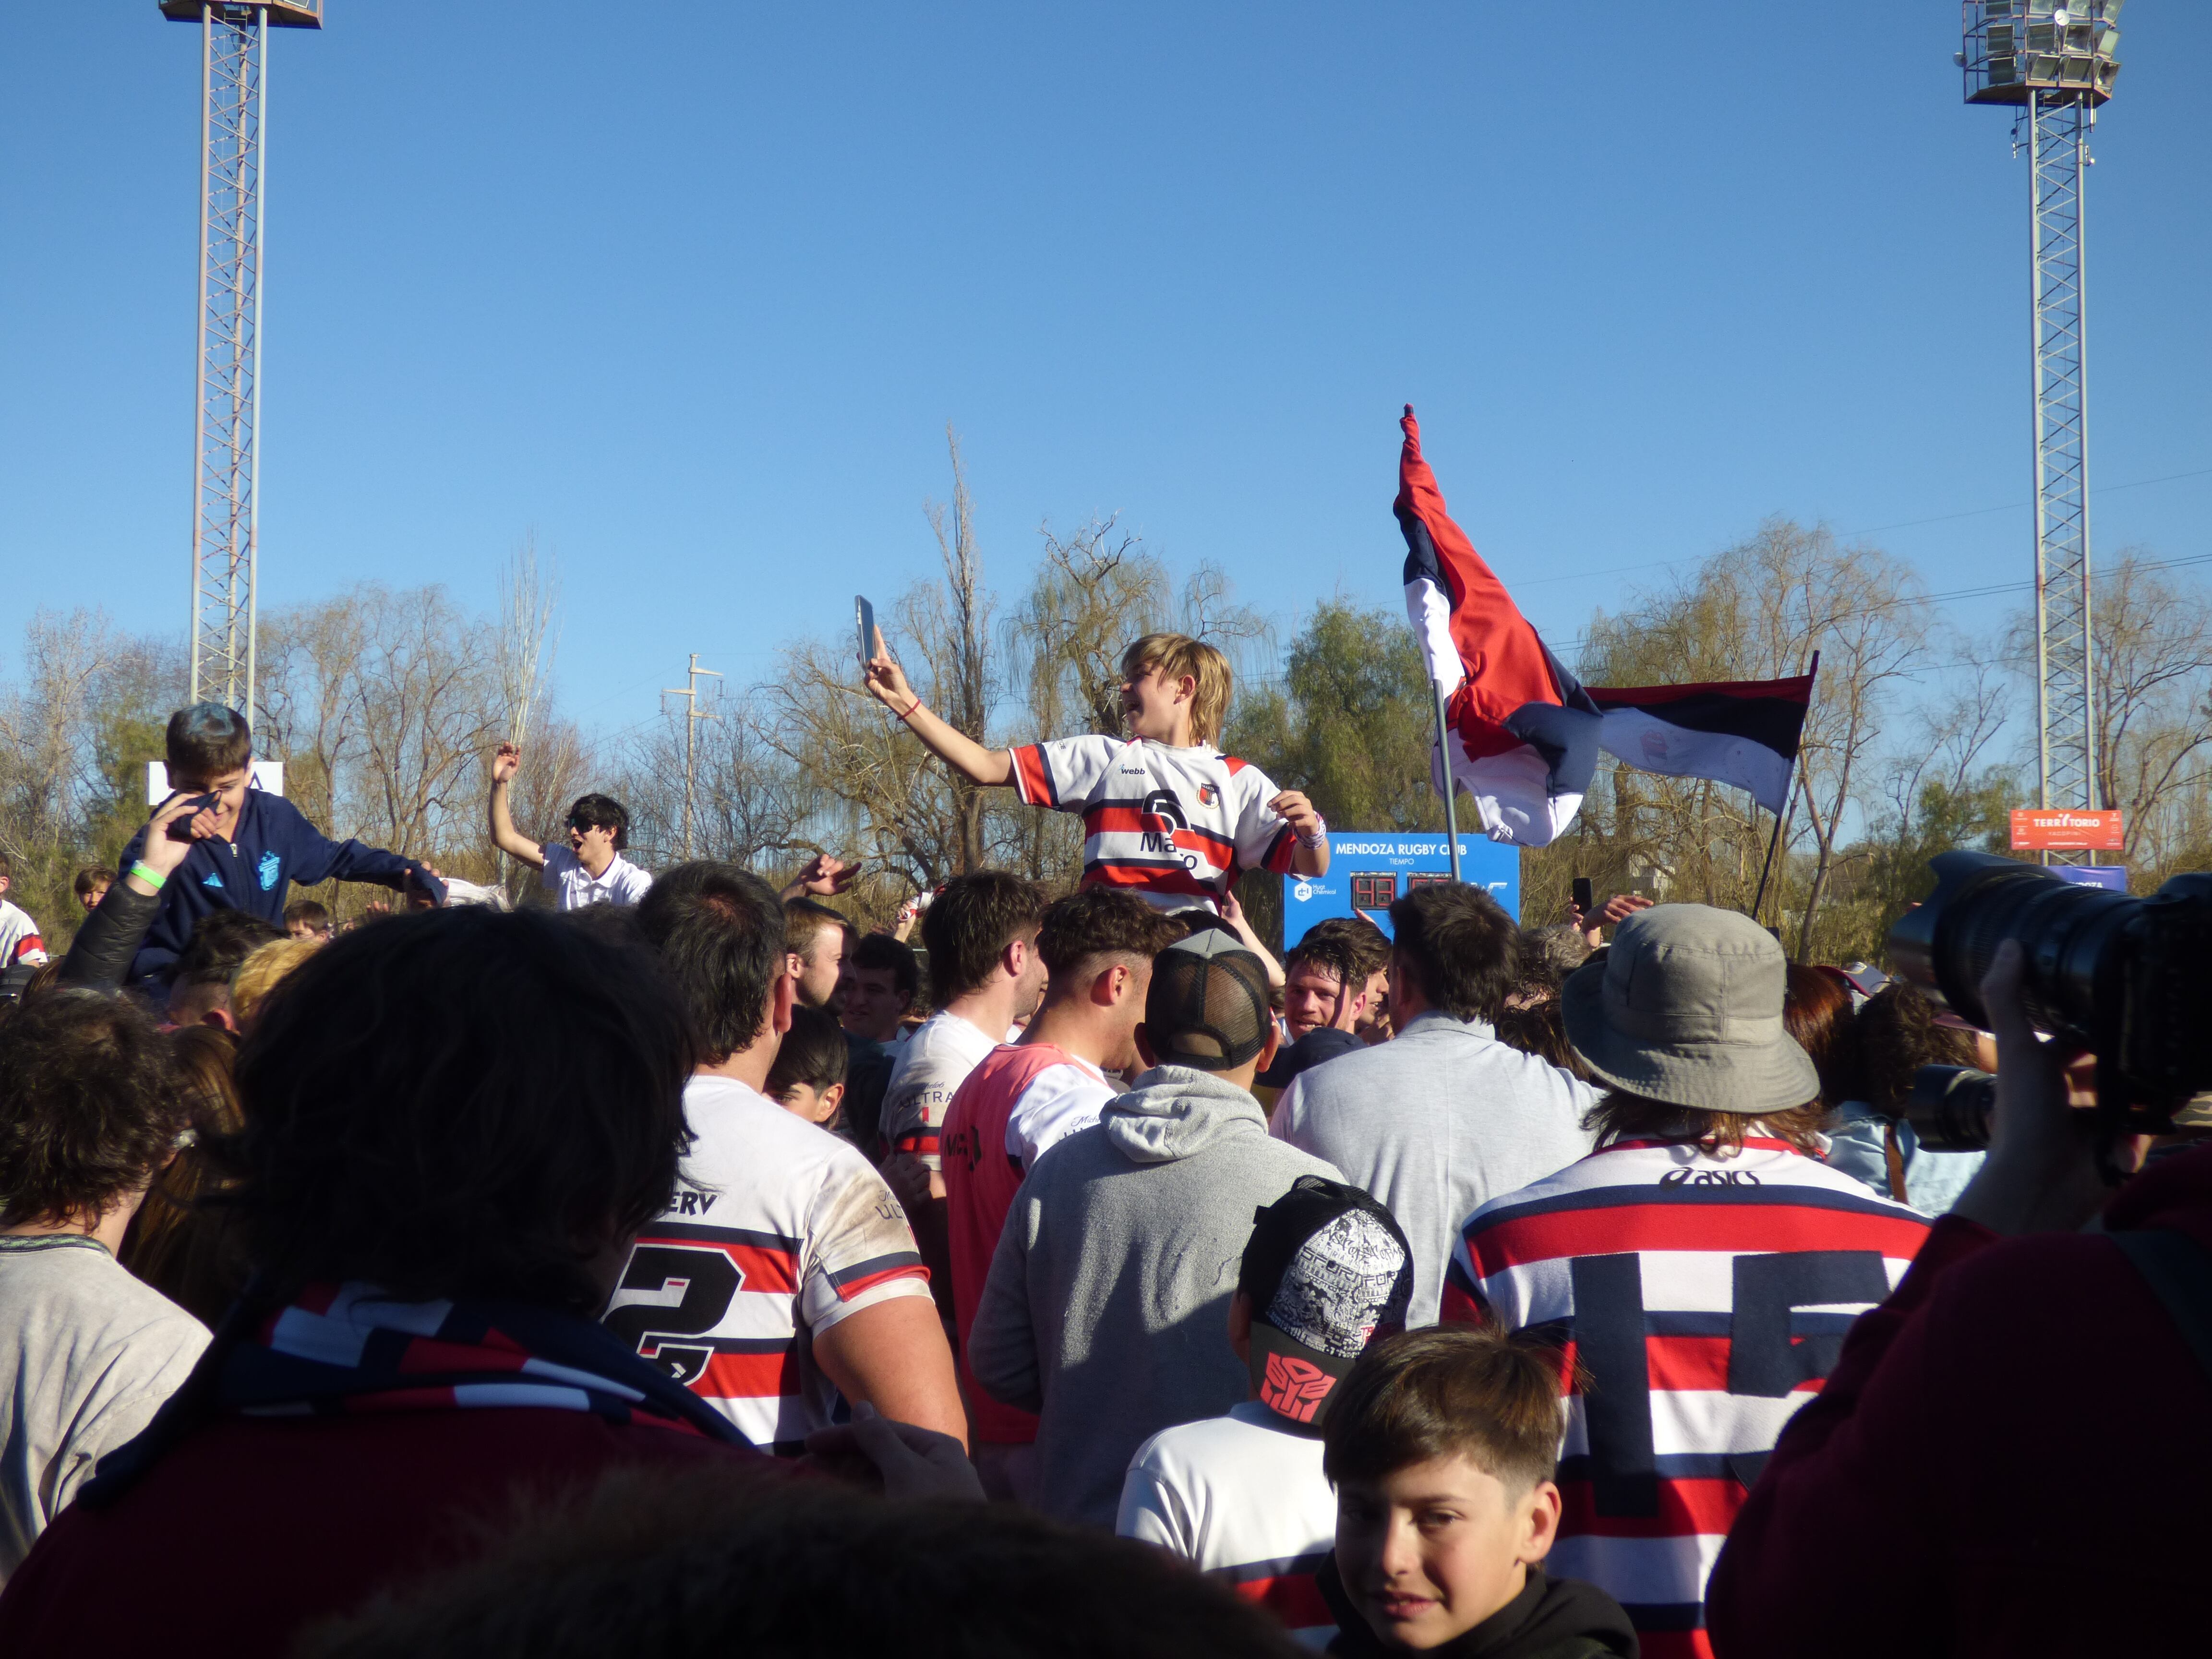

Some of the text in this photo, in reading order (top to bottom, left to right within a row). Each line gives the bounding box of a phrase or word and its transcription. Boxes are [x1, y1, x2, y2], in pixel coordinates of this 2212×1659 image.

[1335, 843, 1395, 855] MENDOZA
[1398, 844, 1437, 855] RUGBY
[1695, 1170, 1761, 1189] asics
